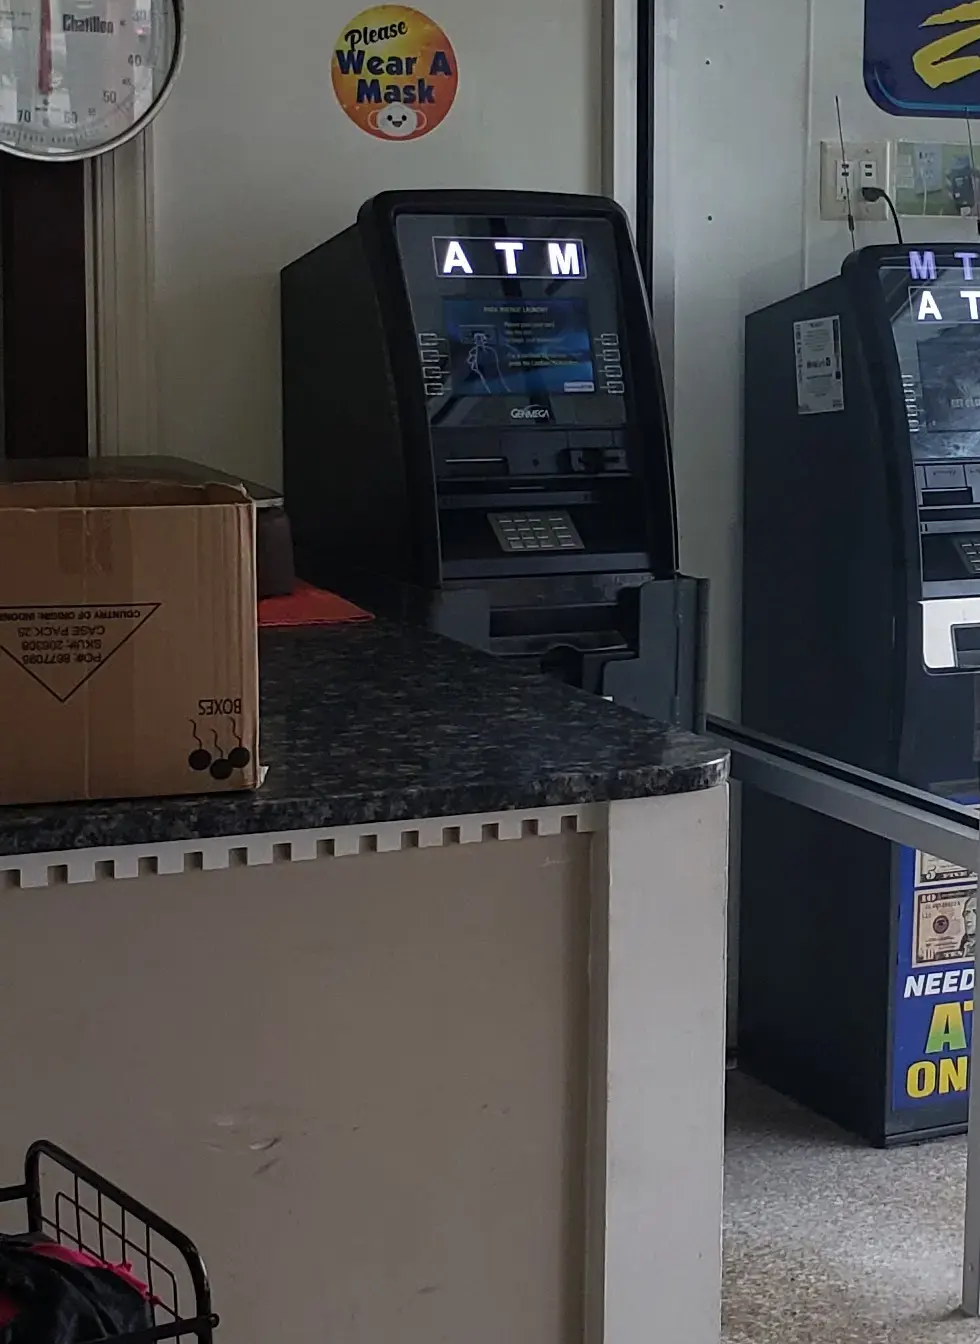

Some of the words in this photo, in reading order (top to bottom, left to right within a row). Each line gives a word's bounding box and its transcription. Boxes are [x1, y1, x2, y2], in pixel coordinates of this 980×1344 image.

[344, 21, 409, 51] Please
[127, 54, 142, 67] 40
[336, 49, 418, 75] Wear
[429, 50, 453, 76] A
[103, 91, 117, 104] 50
[355, 77, 436, 105] Mask
[17, 109, 32, 123] 70
[198, 698, 242, 716] BOXES
